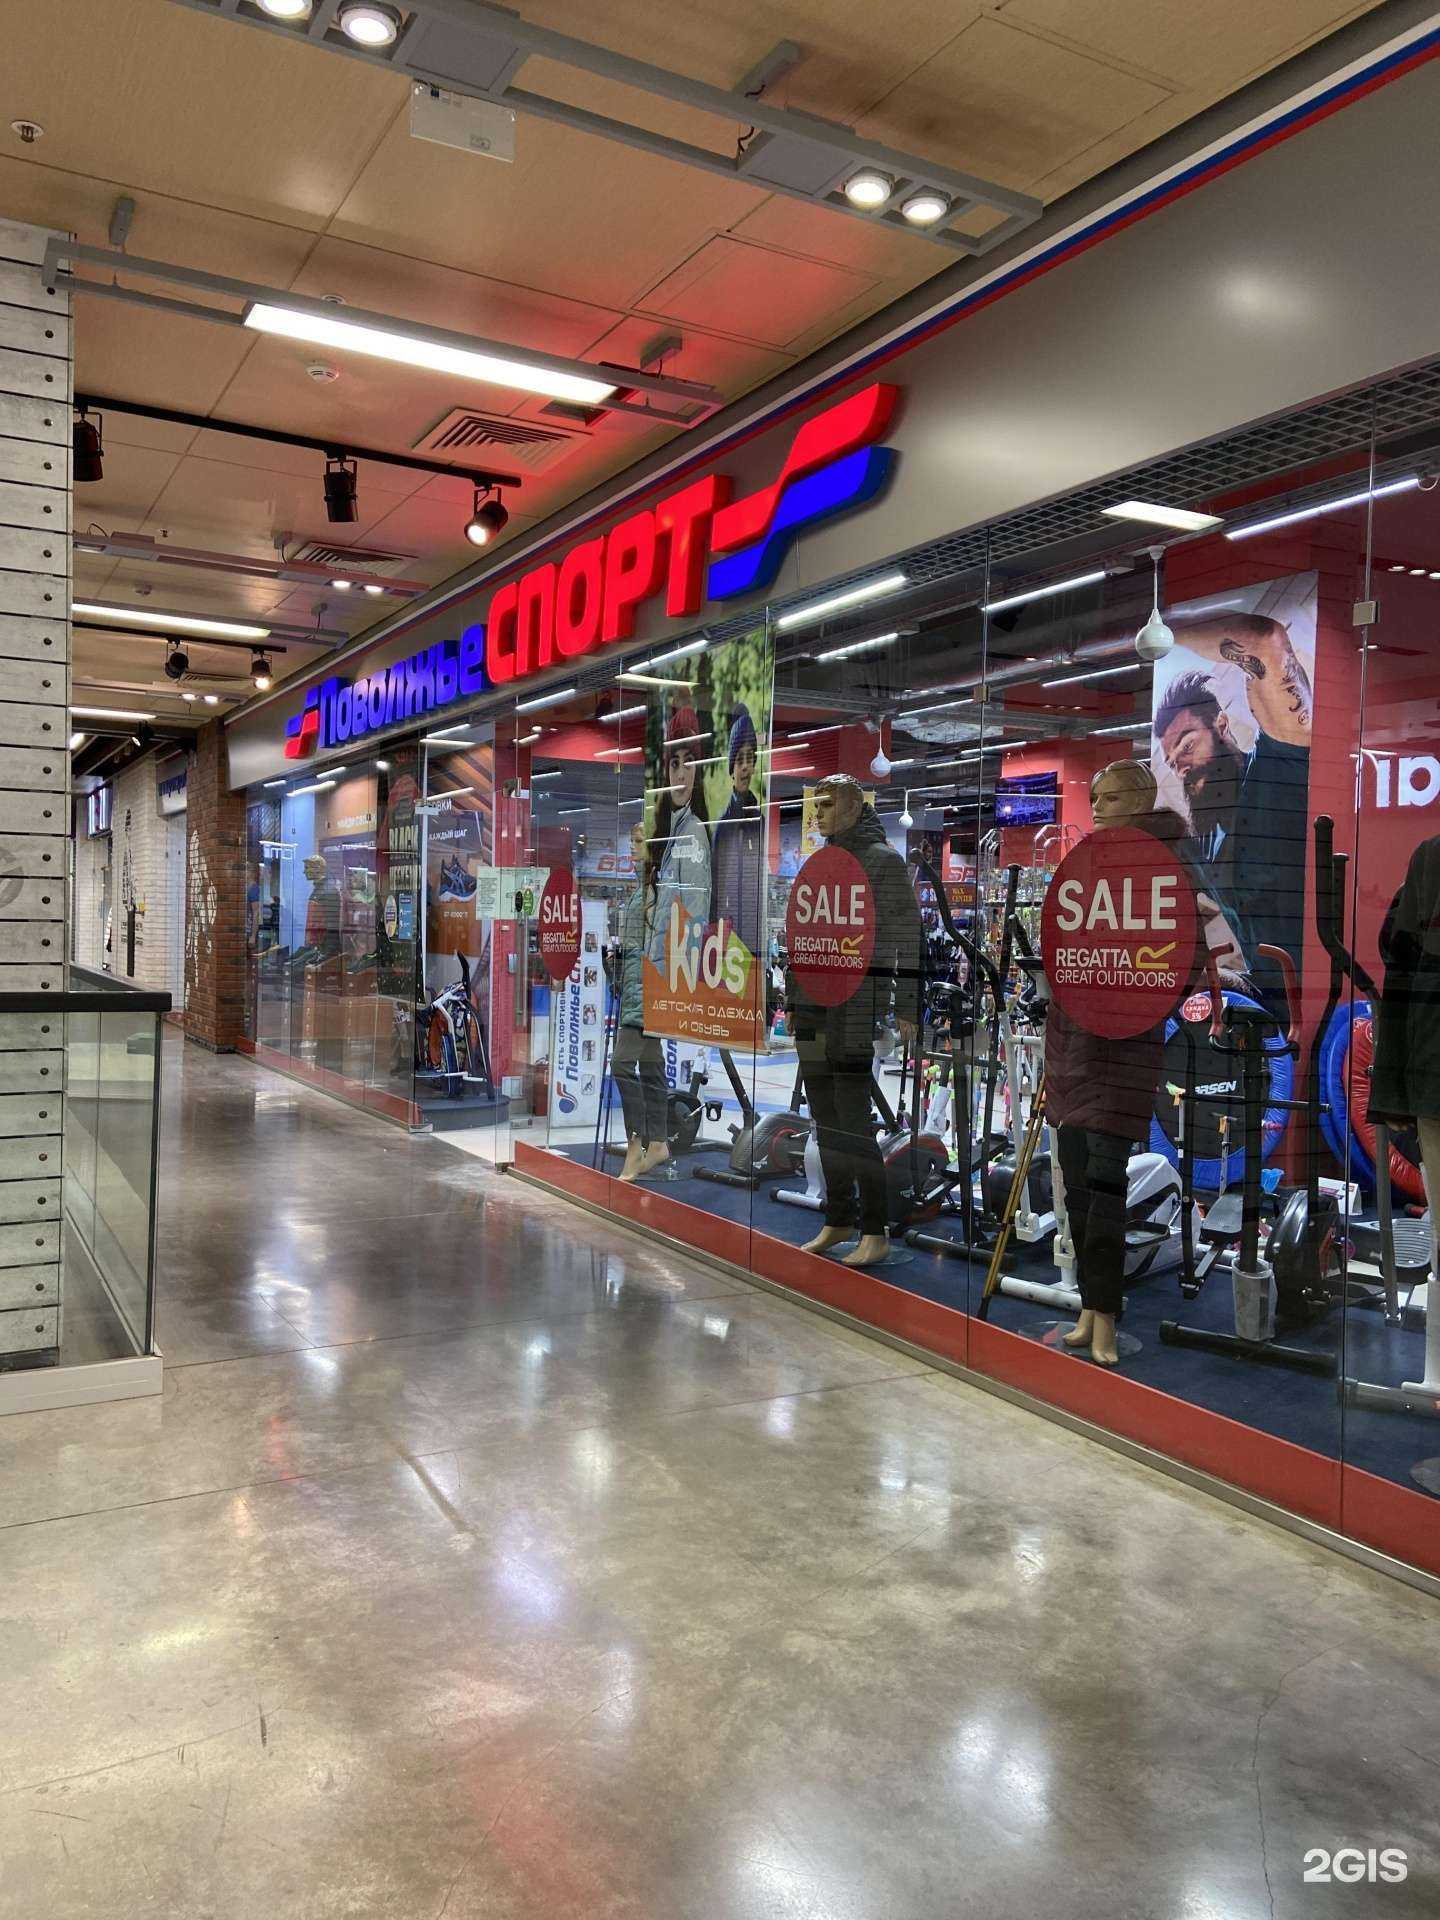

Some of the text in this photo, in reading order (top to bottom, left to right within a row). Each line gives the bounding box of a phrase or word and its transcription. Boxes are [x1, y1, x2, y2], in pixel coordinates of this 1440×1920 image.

[454, 828, 468, 838] ШАГ
[543, 893, 578, 924] SALE
[795, 884, 866, 926] SALE
[1056, 875, 1178, 931] SALE
[542, 932, 565, 943] REGATTA
[794, 936, 840, 954] REGATTA
[542, 943, 577, 953] GREAT OUTDOORS
[669, 902, 745, 994] kids
[794, 952, 864, 969] GREAT OUTDOORS
[1055, 947, 1133, 969] REGATTA
[1055, 969, 1177, 988] GREAT OUTDOORS
[707, 1006, 765, 1023] ОДЕЖДА
[557, 991, 566, 1071] СЕТЬ СПОРТИВН
[678, 1020, 730, 1037] И ОБУВЬ
